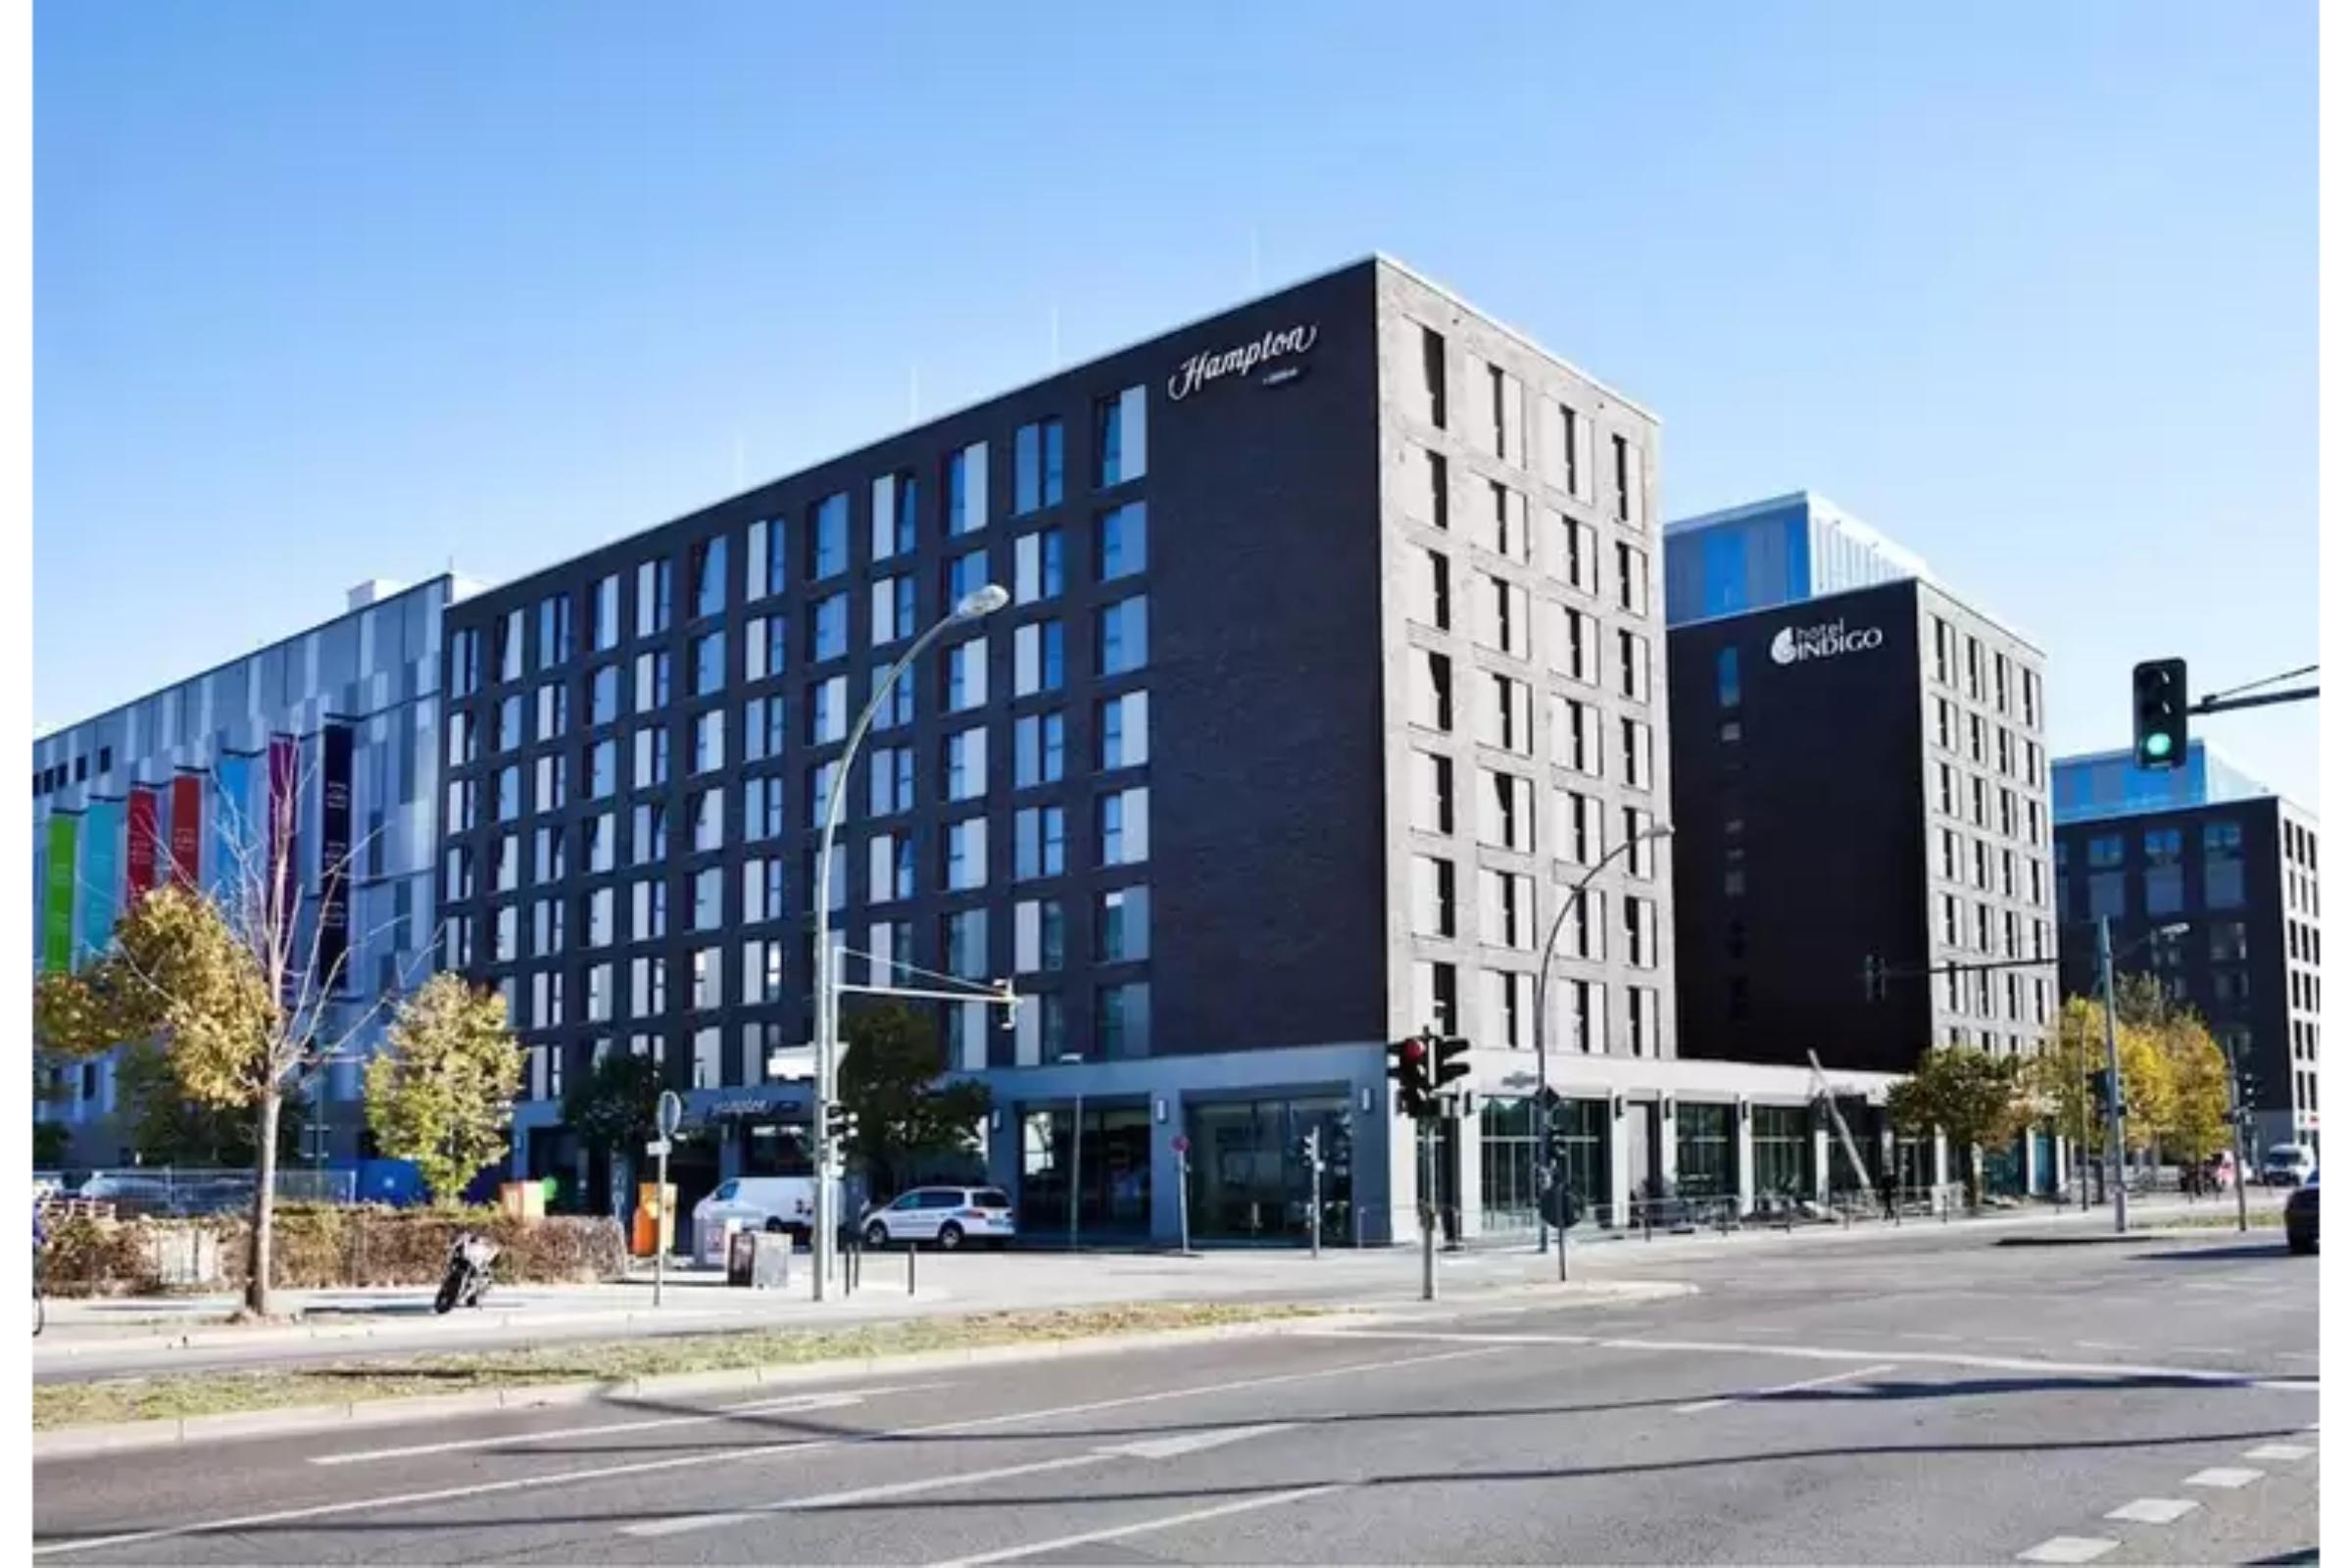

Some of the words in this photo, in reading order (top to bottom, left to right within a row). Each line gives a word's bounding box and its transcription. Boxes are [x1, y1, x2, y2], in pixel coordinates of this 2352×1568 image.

[1168, 324, 1318, 400] Hampton
[1795, 617, 1843, 642] hotel
[1797, 628, 1883, 661] INDIGO
